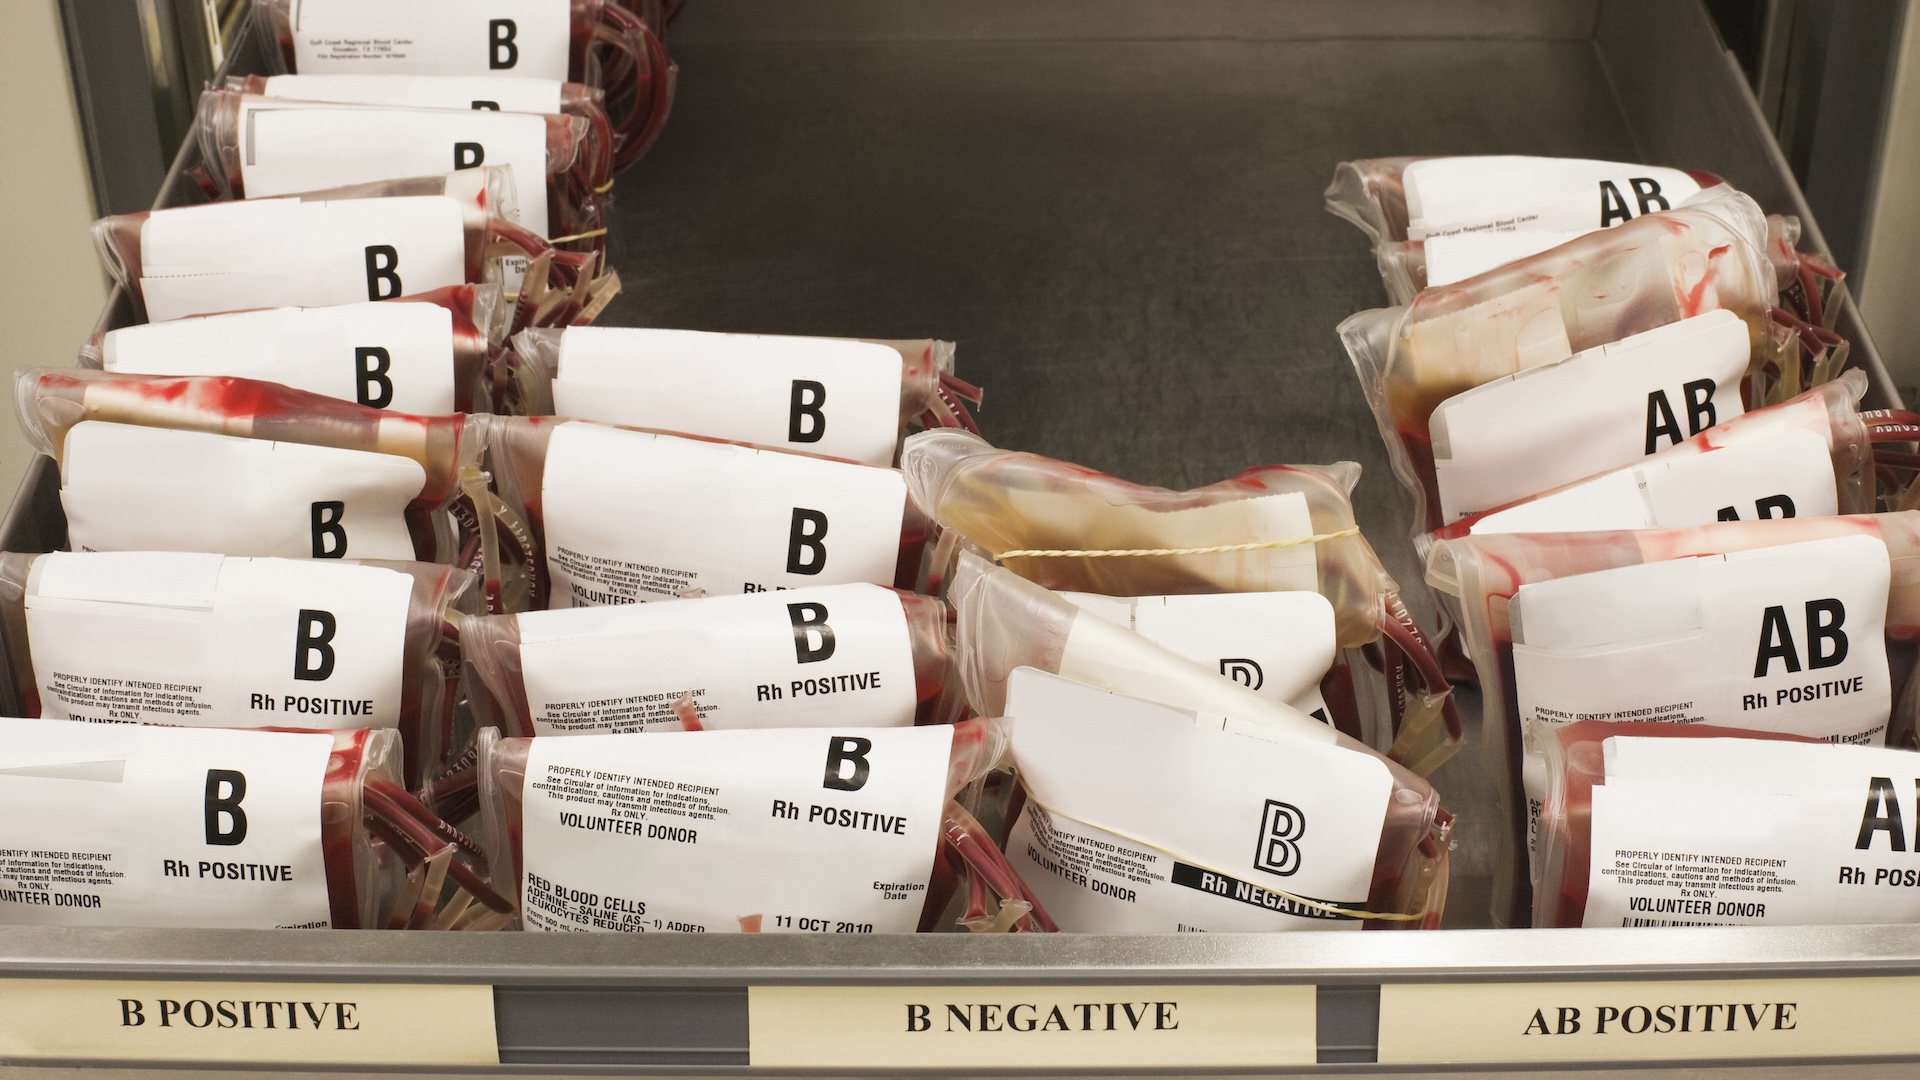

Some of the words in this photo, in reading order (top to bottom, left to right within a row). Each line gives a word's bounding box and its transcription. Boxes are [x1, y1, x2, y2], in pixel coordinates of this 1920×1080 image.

[488, 18, 518, 70] B
[1496, 218, 1514, 227] Blood
[1517, 215, 1538, 223] Center
[365, 244, 402, 301] B
[355, 346, 394, 408] B
[788, 379, 826, 443] B
[1644, 377, 1718, 456] AB
[312, 501, 347, 558] B
[786, 507, 829, 576] B
[558, 547, 589, 561] PROPERLY
[592, 557, 622, 567] IDENTIFY
[625, 562, 659, 573] INTENDED
[662, 568, 698, 579] RECIPIENT
[294, 609, 336, 681] B
[787, 601, 836, 664] B
[1754, 597, 1849, 679] AB
[54, 672, 87, 683] PROPERLY
[90, 677, 123, 687] IDENTIFY
[126, 681, 161, 690] INTENDED
[165, 683, 202, 693] RECIPIENT
[757, 684, 783, 702] Rh
[791, 672, 882, 697] POSITIVE
[1743, 692, 1768, 711] Rh
[1776, 676, 1864, 707] POSITIVE
[120, 711, 142, 719] ONLY.
[250, 693, 275, 711] Rh
[284, 696, 373, 716] POSITIVE
[545, 702, 585, 710] PROPERLY
[588, 698, 623, 709] IDENTIFY
[626, 693, 664, 705] INTENDED
[1535, 706, 1573, 719] PROPERLY
[1614, 708, 1652, 719] INTENDED
[1655, 701, 1693, 714] RECIPIENT
[1842, 725, 1884, 743] Expiration
[823, 735, 872, 792] B
[547, 776, 561, 785] See
[564, 778, 594, 789] Circular
[596, 782, 604, 791] of
[653, 790, 664, 799] for
[548, 765, 591, 778] PROPERLY
[593, 771, 632, 784] IDENTIFY
[634, 777, 674, 790] INTENDED
[677, 783, 720, 796] RECIPIENT
[204, 768, 247, 846] B
[547, 791, 564, 800] This
[566, 794, 595, 806] product
[597, 799, 614, 809] may
[616, 800, 647, 811] transmit
[689, 811, 716, 822] agents.
[602, 791, 634, 802] cautions
[637, 795, 650, 804] and
[653, 797, 686, 809] methods
[688, 802, 696, 810] of
[611, 809, 621, 817] Rx
[624, 810, 648, 821] ONLY.
[1855, 777, 1920, 852] A
[560, 812, 642, 837] VOLUNTEER
[648, 824, 697, 844] DONOR
[772, 799, 800, 821] Rh
[809, 805, 907, 836] POSITIVE
[1077, 836, 1115, 852] INTENDED
[1117, 848, 1157, 863] RECIPIENT
[1254, 798, 1306, 877] B
[31, 851, 69, 860] INTENDED
[72, 852, 112, 861] RECIPIENT
[163, 859, 189, 877] Rh
[199, 862, 293, 882] POSITIVE
[1615, 850, 1658, 860] PROPERLY
[1662, 853, 1699, 862] IDENTIFY
[1702, 855, 1742, 865] INTENDED
[1745, 857, 1787, 867] RECIPIENT
[1615, 861, 1630, 869] See
[1632, 862, 1662, 870] Circular
[1721, 867, 1731, 875] for
[30, 882, 52, 890] ONLY.
[873, 881, 925, 891] Expiration
[1027, 842, 1087, 888] VOLUNTEER
[1092, 879, 1136, 903] DONOR
[1618, 877, 1633, 885] This
[1636, 878, 1664, 888] product
[1667, 881, 1683, 889] may
[1685, 881, 1716, 889] transmit
[1757, 886, 1784, 894] agents.
[1671, 872, 1703, 881] cautions
[1722, 875, 1754, 883] methods
[1839, 866, 1865, 884] Rh
[55, 893, 101, 908] DONOR
[528, 872, 550, 892] RED
[555, 884, 598, 906] BLOOD
[604, 896, 646, 915] CELLS
[883, 892, 907, 900] Date
[1201, 872, 1228, 894] Rh
[1235, 880, 1338, 918] NEGATIVE
[1630, 897, 1712, 915] VOLUNTEER
[1717, 902, 1766, 917] DONOR
[1681, 889, 1690, 897] Rx
[1693, 890, 1717, 898] ONLY.
[527, 894, 589, 924] LEUKOCYTES
[593, 916, 644, 932] REDUCED
[667, 921, 705, 933] ADDED
[776, 915, 791, 928] 11
[799, 917, 830, 932] OCT
[836, 922, 873, 933] 2010
[118, 999, 146, 1026] B
[156, 1000, 360, 1030] POSITIVE
[904, 1004, 931, 1032] B
[944, 1002, 1180, 1032] NEGATIVE
[1522, 1007, 1581, 1035] AB
[1593, 1002, 1798, 1033] POSITIVE
